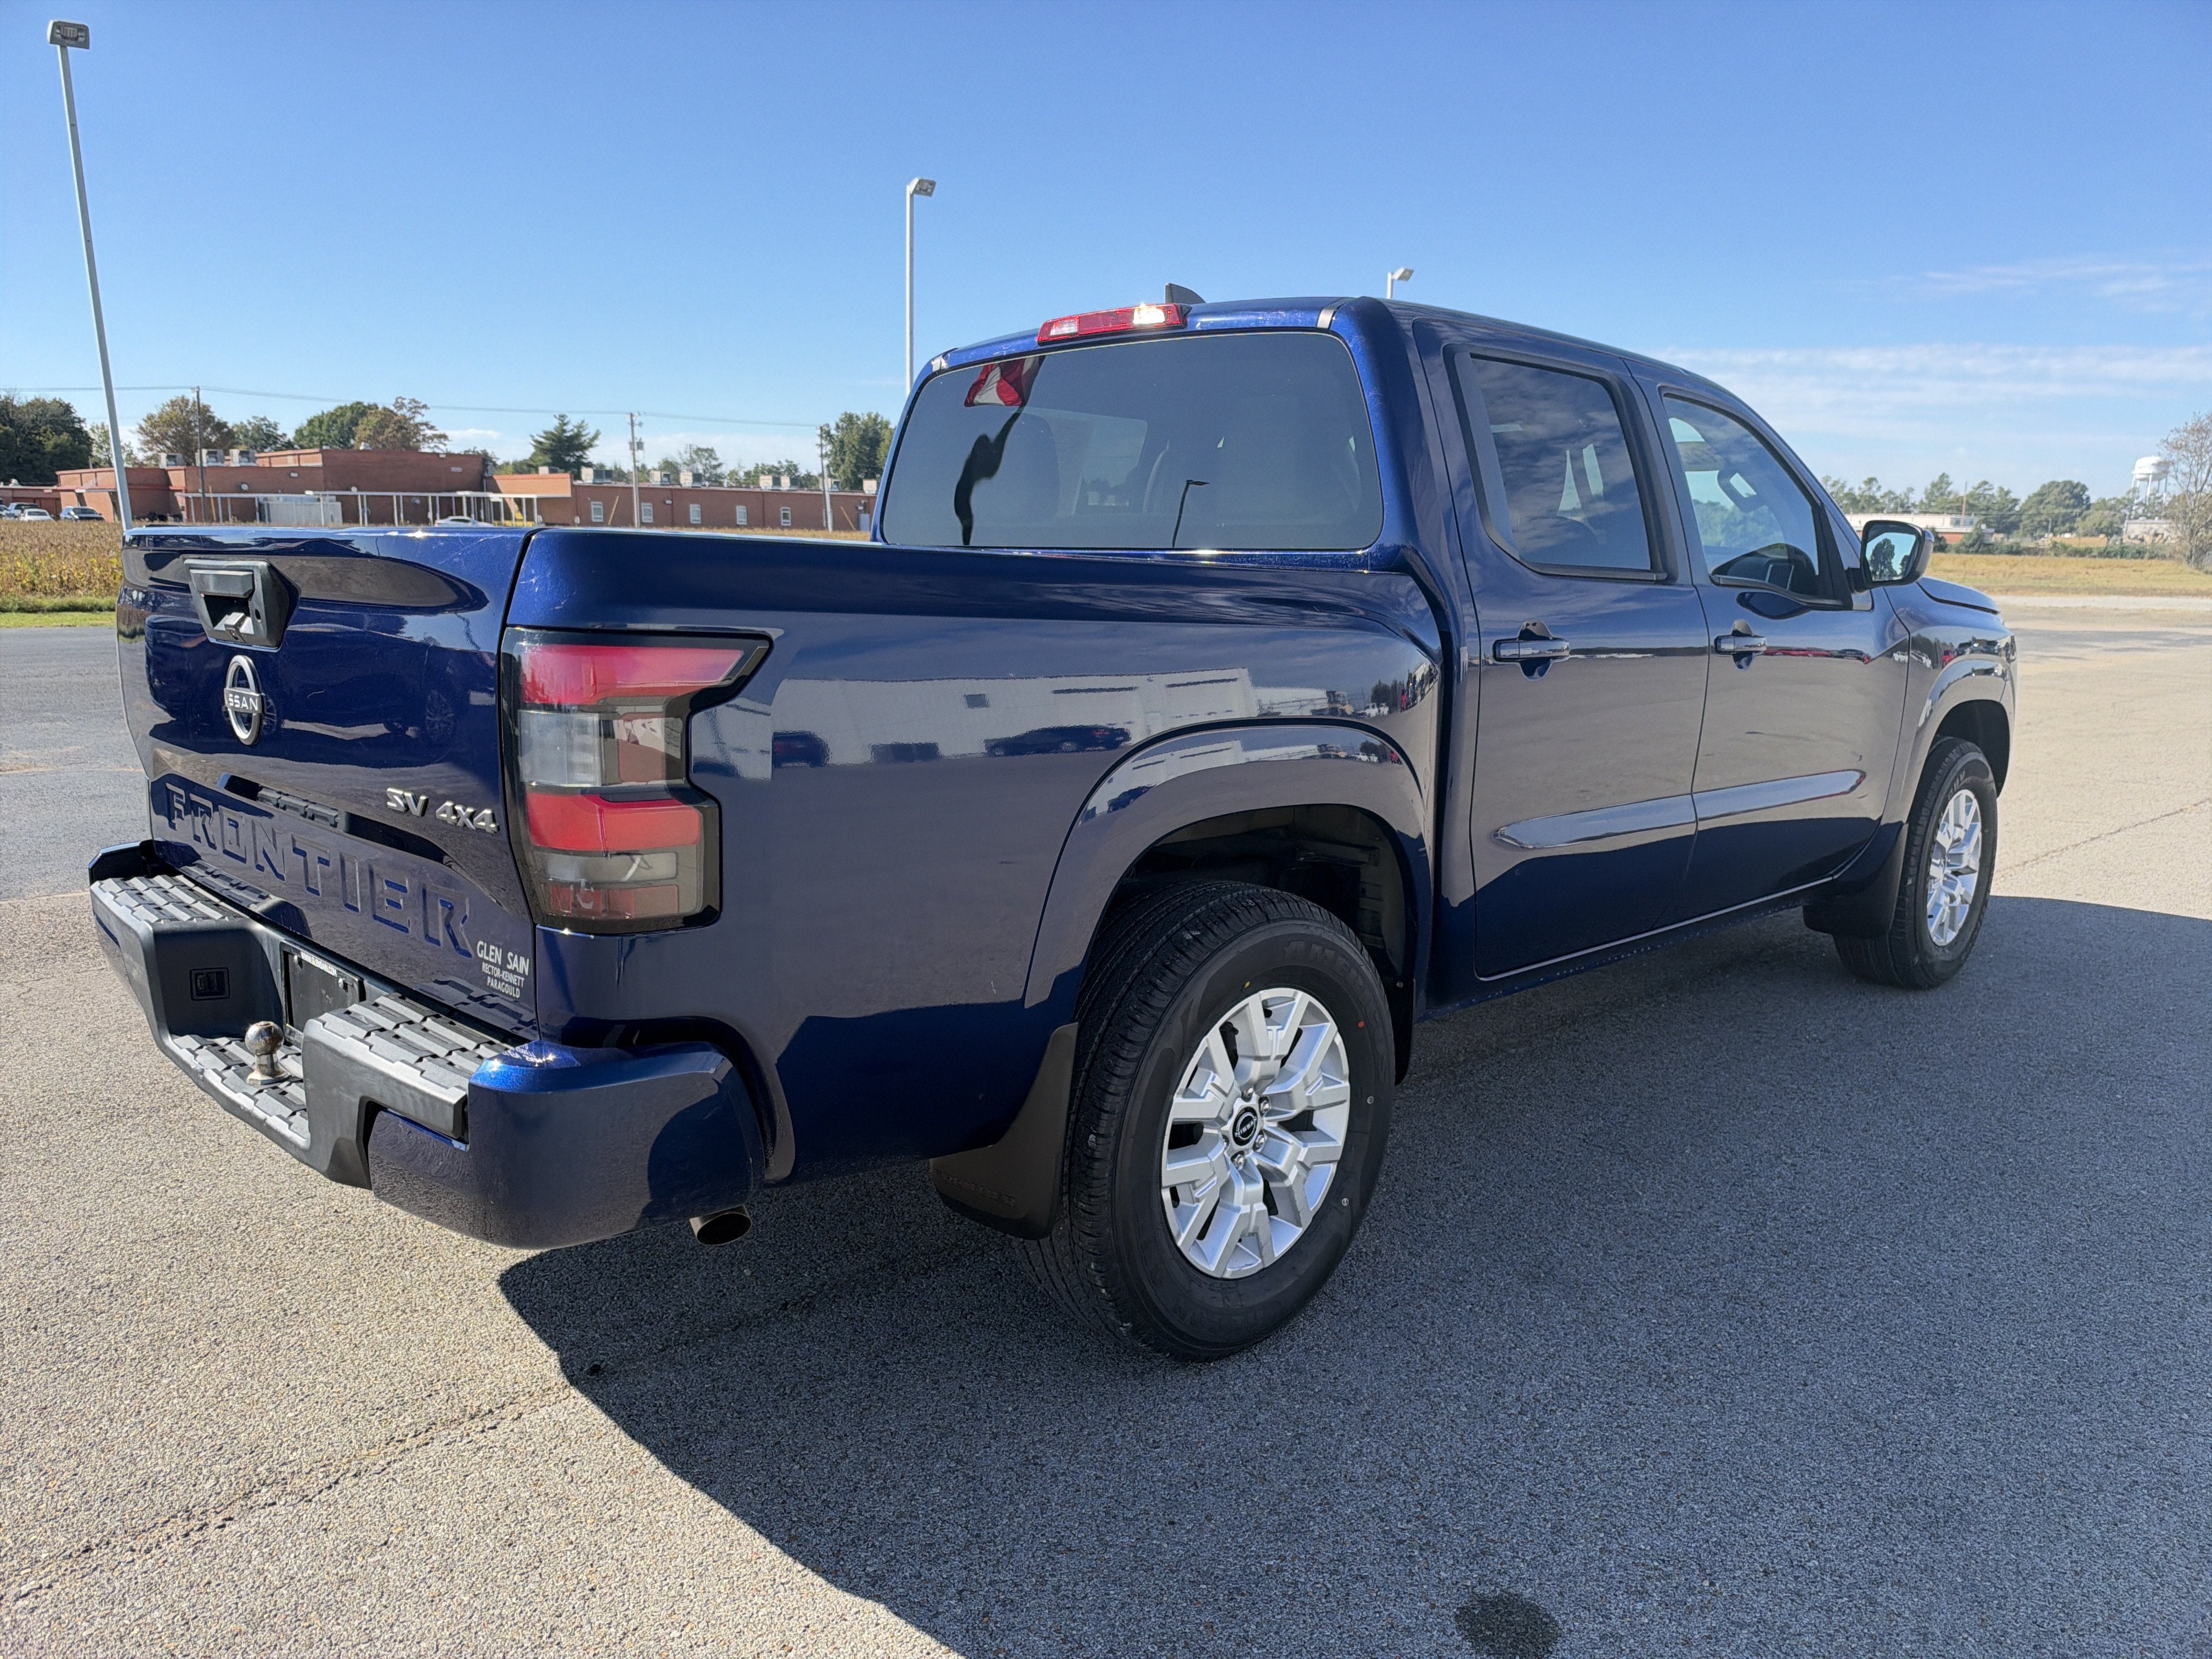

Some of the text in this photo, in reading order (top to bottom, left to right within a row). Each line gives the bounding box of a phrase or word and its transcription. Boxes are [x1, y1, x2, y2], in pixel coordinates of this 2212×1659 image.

[227, 692, 259, 712] SSAN
[386, 787, 429, 817] SV
[165, 781, 473, 960] FRONTIER
[477, 940, 529, 976] GLEN SAIN
[482, 962, 525, 988] RECTOR-KENNETT
[487, 976, 521, 998] PARAGOULD
[1234, 1116, 1257, 1137] NISSAN
